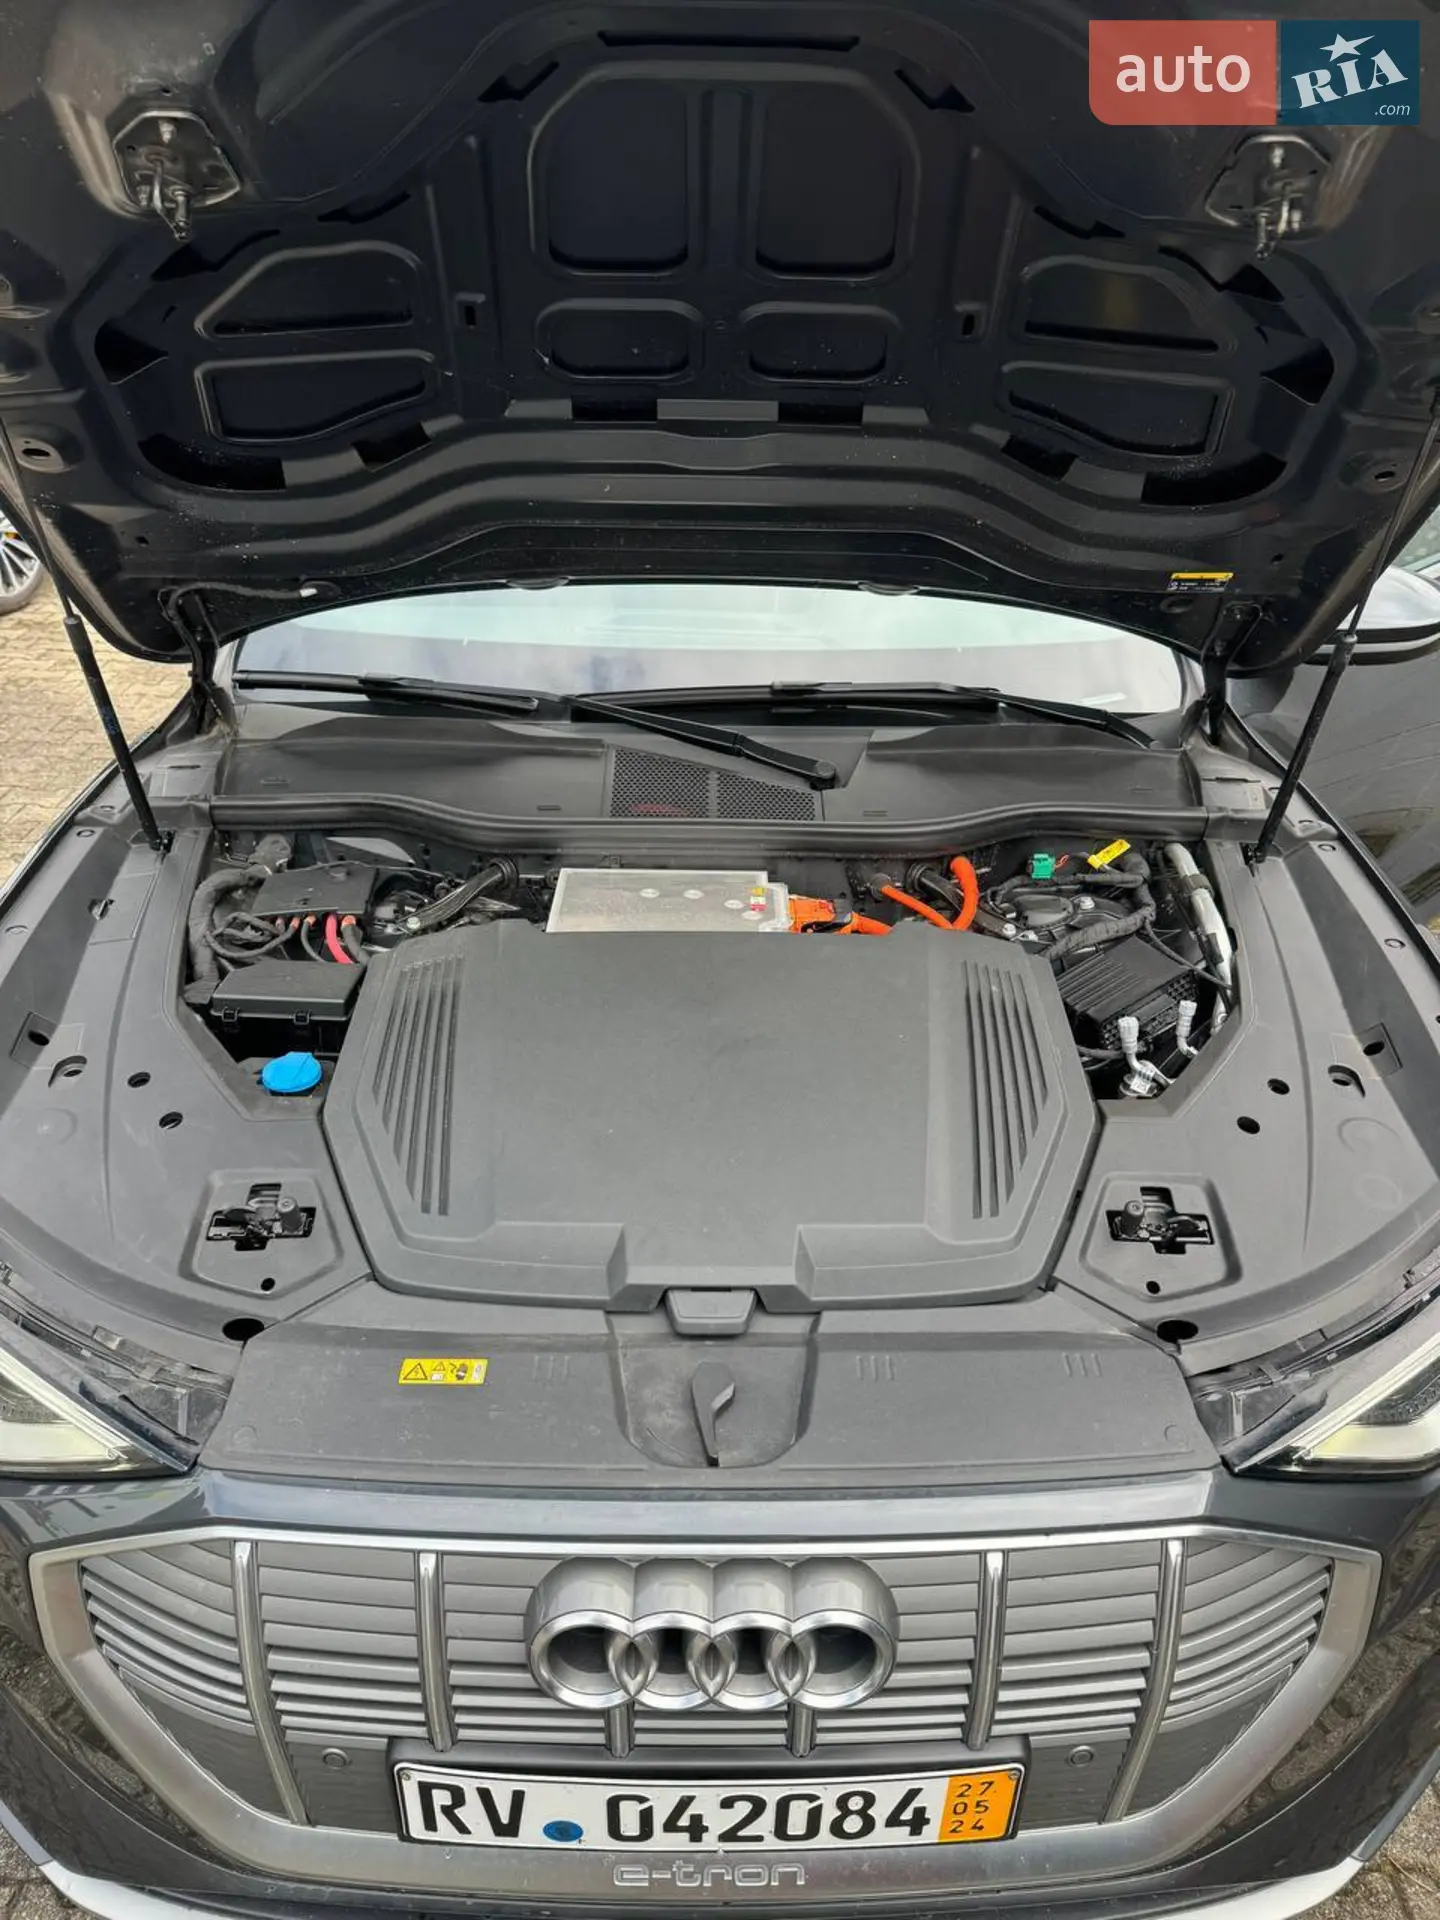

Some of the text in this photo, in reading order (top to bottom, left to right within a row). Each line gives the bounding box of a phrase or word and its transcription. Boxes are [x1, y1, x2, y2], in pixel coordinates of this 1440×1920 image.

[955, 1780, 995, 1798] 27
[417, 1780, 931, 1844] RV 042084
[952, 1799, 990, 1816] 05
[948, 1817, 985, 1834] 24
[613, 1859, 805, 1887] e-tron
